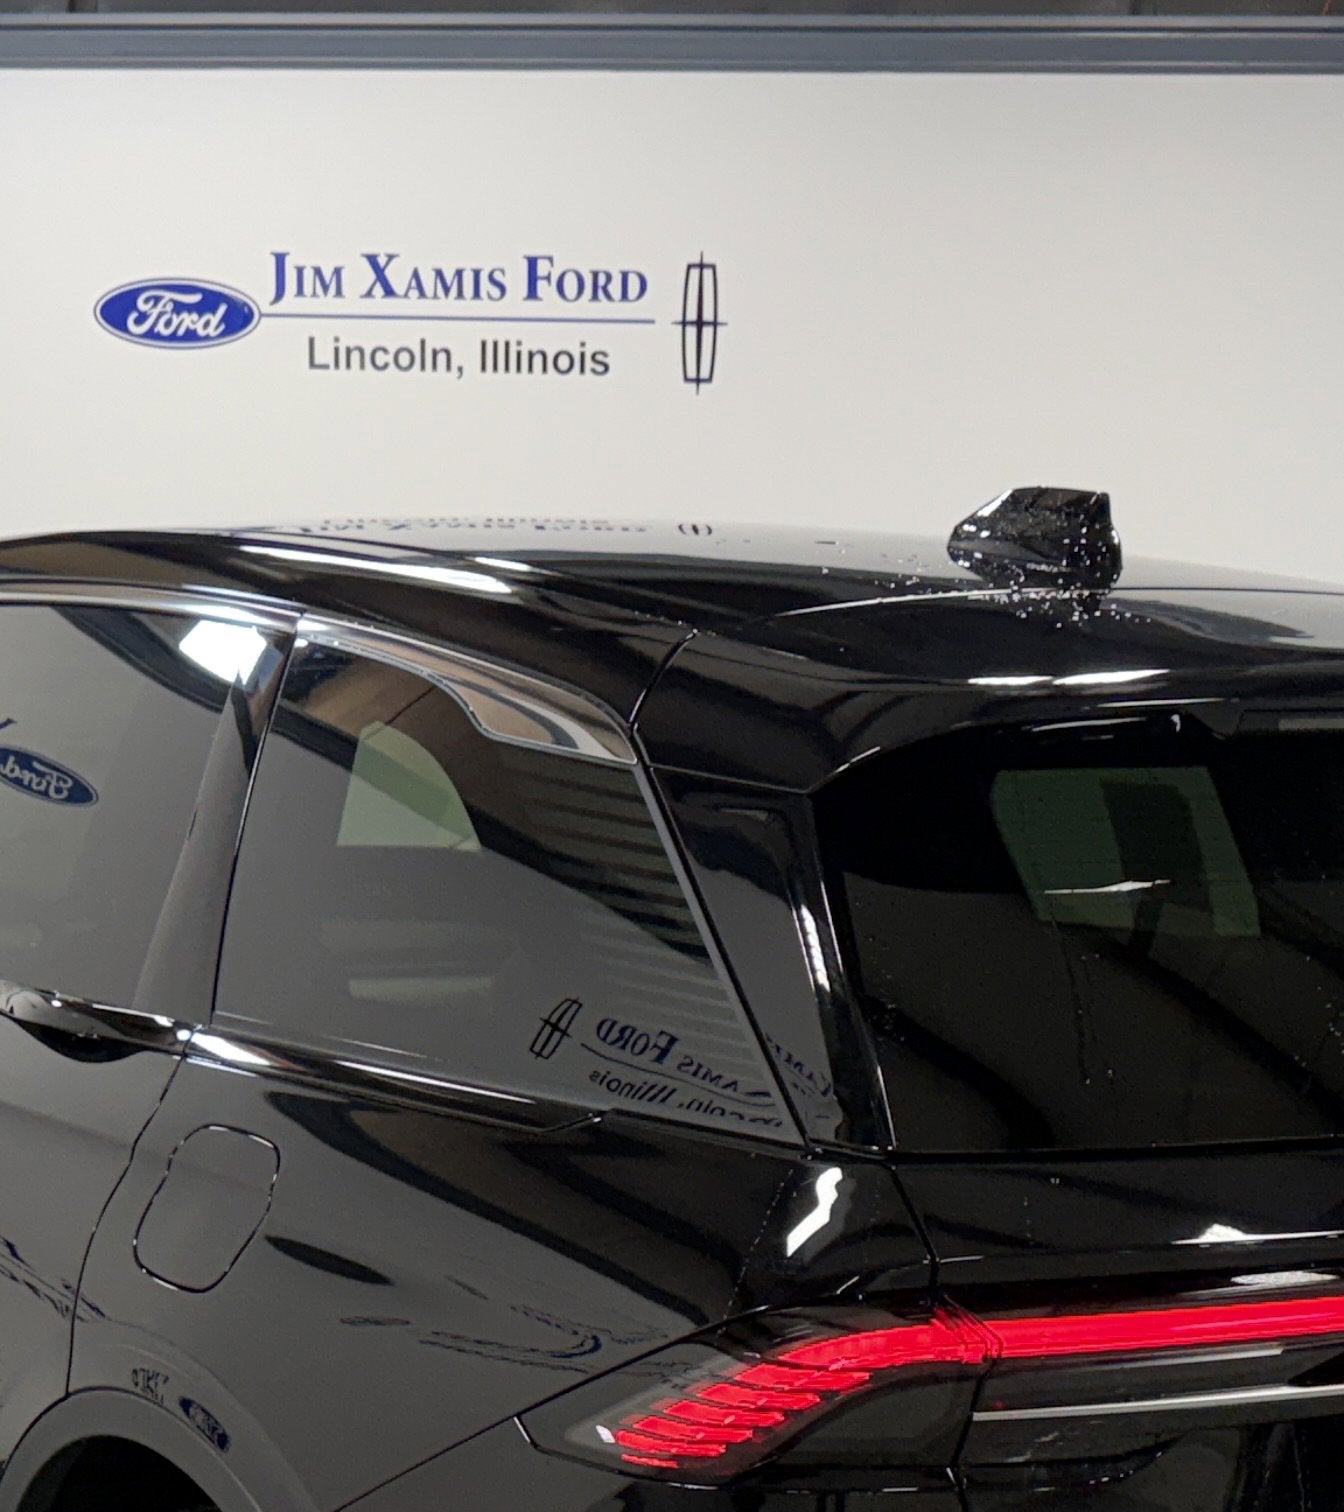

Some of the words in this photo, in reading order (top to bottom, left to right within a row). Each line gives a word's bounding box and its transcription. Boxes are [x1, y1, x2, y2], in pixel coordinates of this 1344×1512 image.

[269, 252, 345, 305] JIM
[361, 253, 507, 302] XAMIS
[523, 255, 648, 303] FORD
[125, 290, 227, 338] Ford
[307, 337, 465, 379] Lincoln,
[479, 340, 611, 376] Illinois
